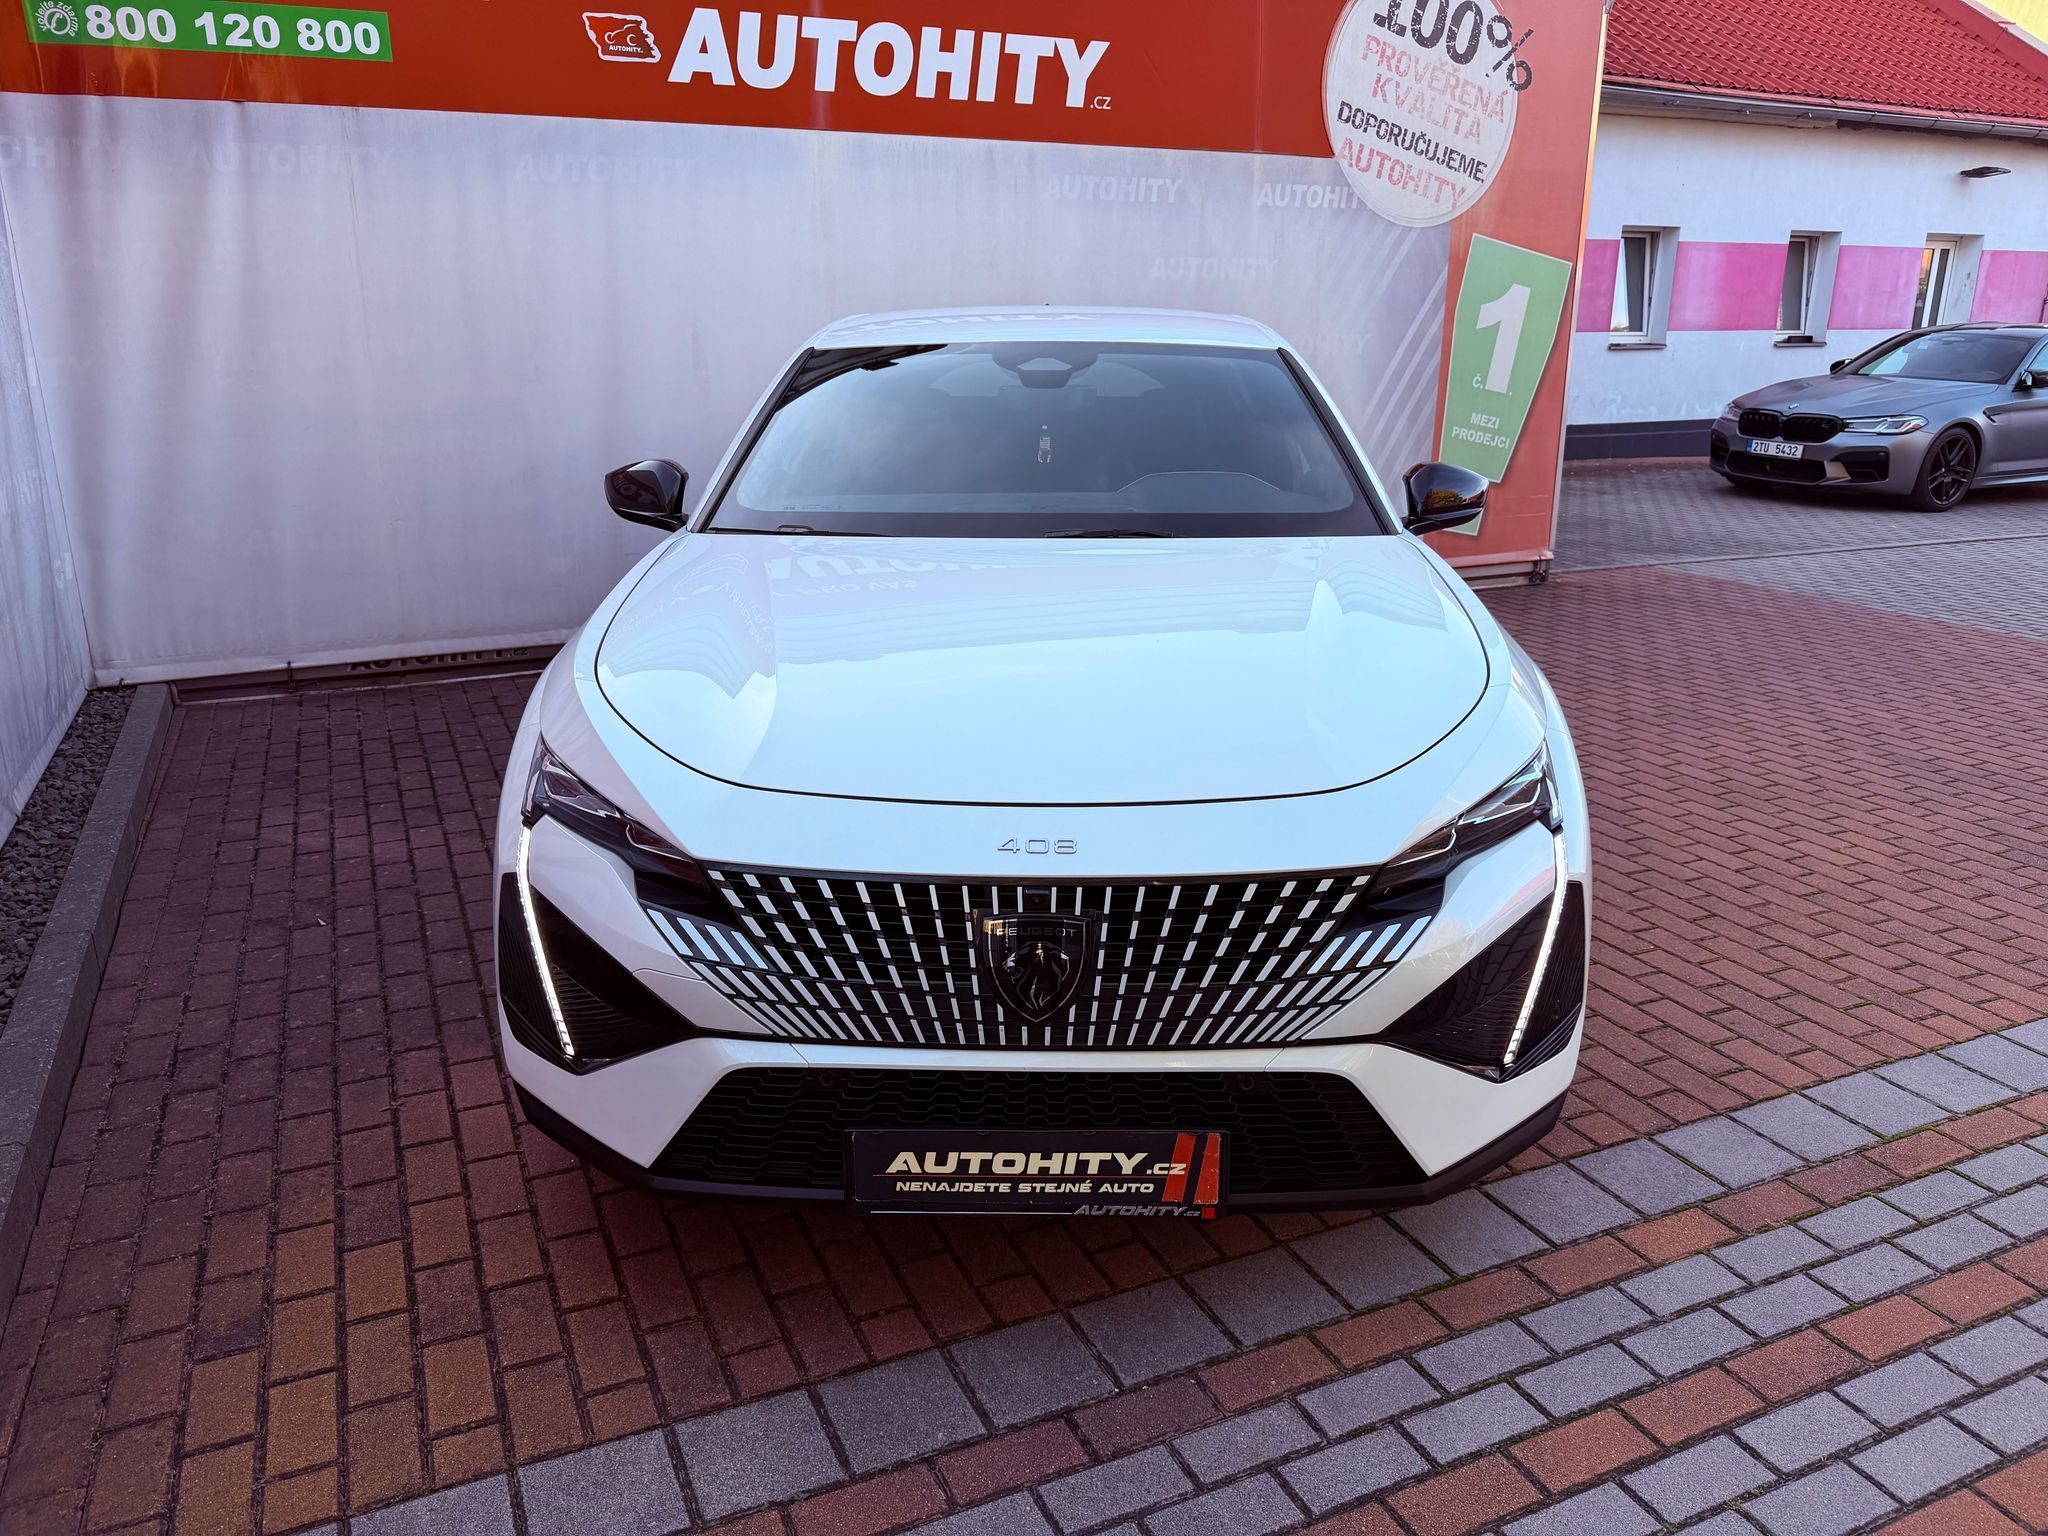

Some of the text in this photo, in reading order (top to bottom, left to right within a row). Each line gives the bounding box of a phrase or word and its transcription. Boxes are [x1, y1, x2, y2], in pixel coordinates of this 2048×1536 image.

[57, 1, 78, 37] zdarma
[85, 5, 380, 55] 800 120 800
[1373, 0, 1534, 92] 100%
[1362, 34, 1508, 123] PROVĚŘENÁ
[1372, 73, 1481, 144] KVALITA
[1337, 100, 1488, 184] DOPORUČUJEME
[1339, 137, 1467, 210] AUTOHITY
[1046, 174, 1183, 204] AUTOHITY
[1256, 182, 1368, 209] AUTOHIT
[1470, 412, 1500, 429] MEZI
[1451, 426, 1510, 450] PRODEJCI
[1753, 442, 1799, 457] 2TU 5432
[997, 837, 1078, 854] 408
[996, 927, 1078, 936] PEUGEOT
[896, 1179, 1154, 1194] NENAJDETE STEJNÉ AUTO
